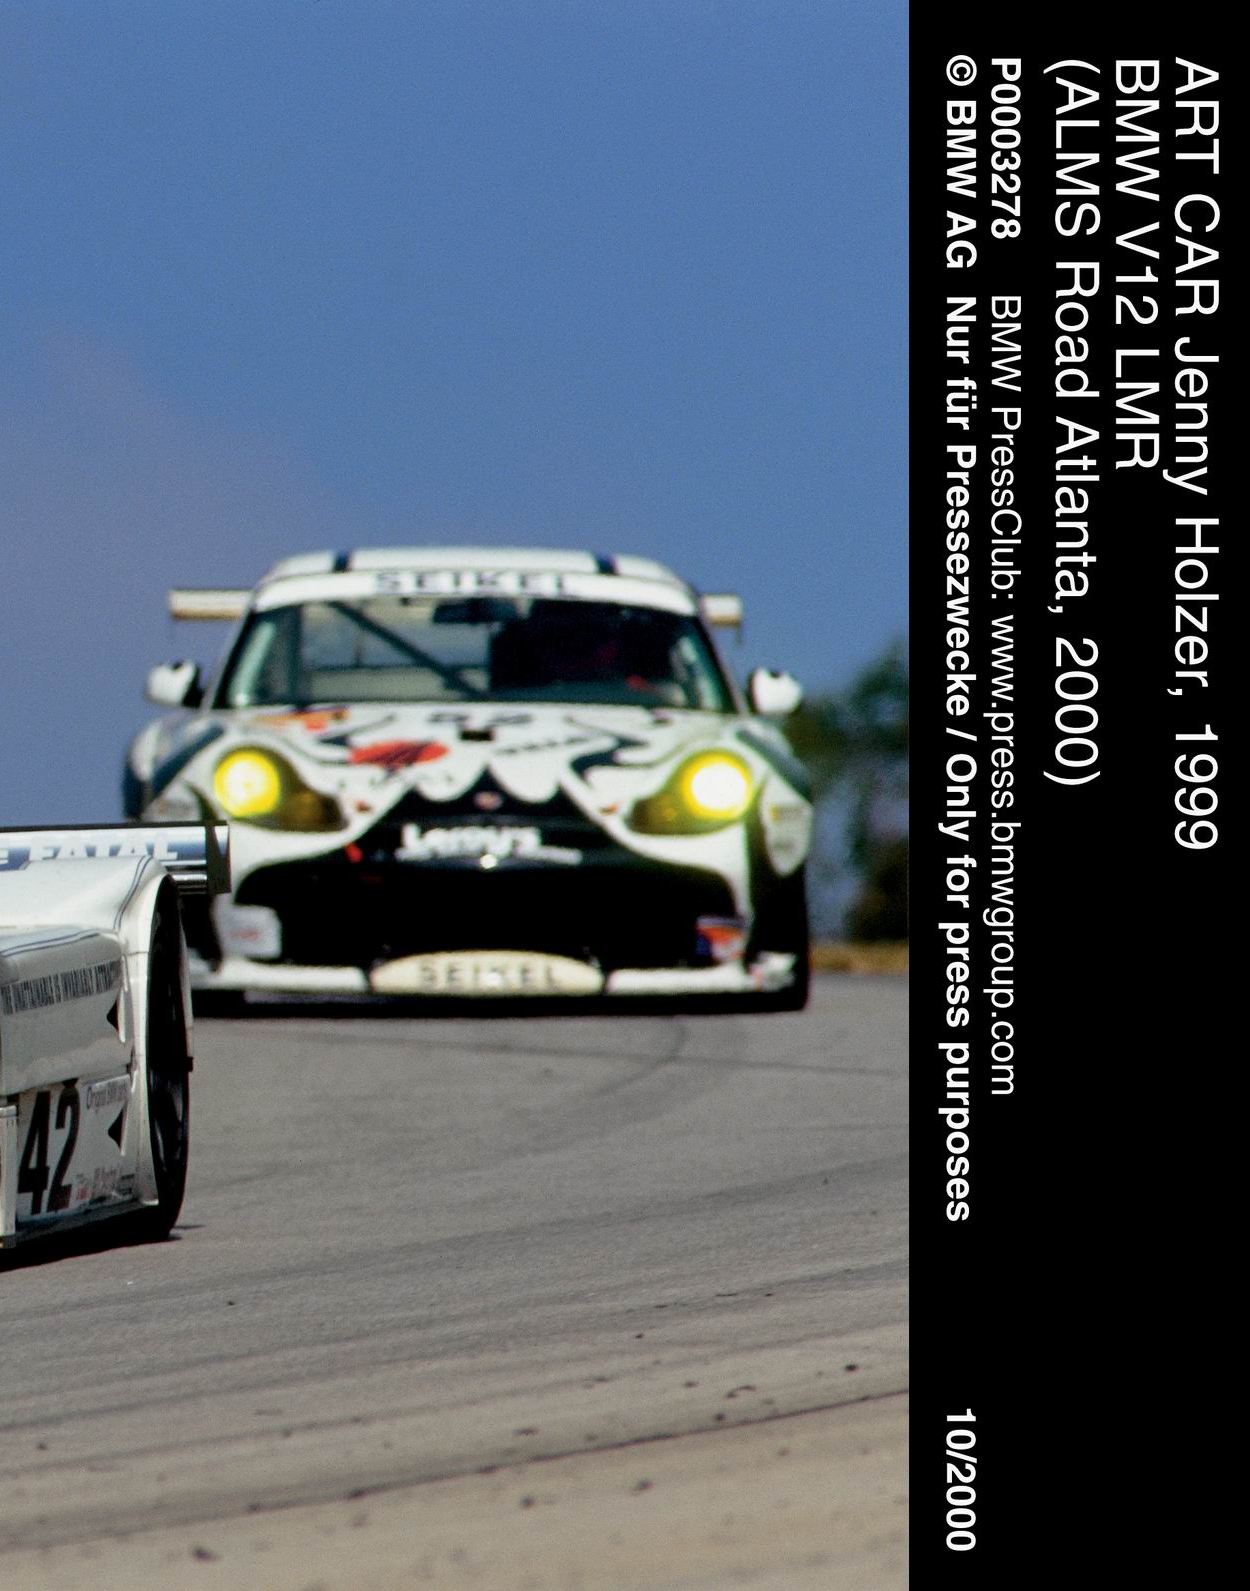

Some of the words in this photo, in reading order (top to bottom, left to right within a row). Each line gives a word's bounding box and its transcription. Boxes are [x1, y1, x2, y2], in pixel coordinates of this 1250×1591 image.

[374, 570, 571, 596] SEIKEL
[29, 833, 179, 861] FATAL
[417, 958, 563, 991] SEIKEL
[17, 1085, 81, 1216] 42
